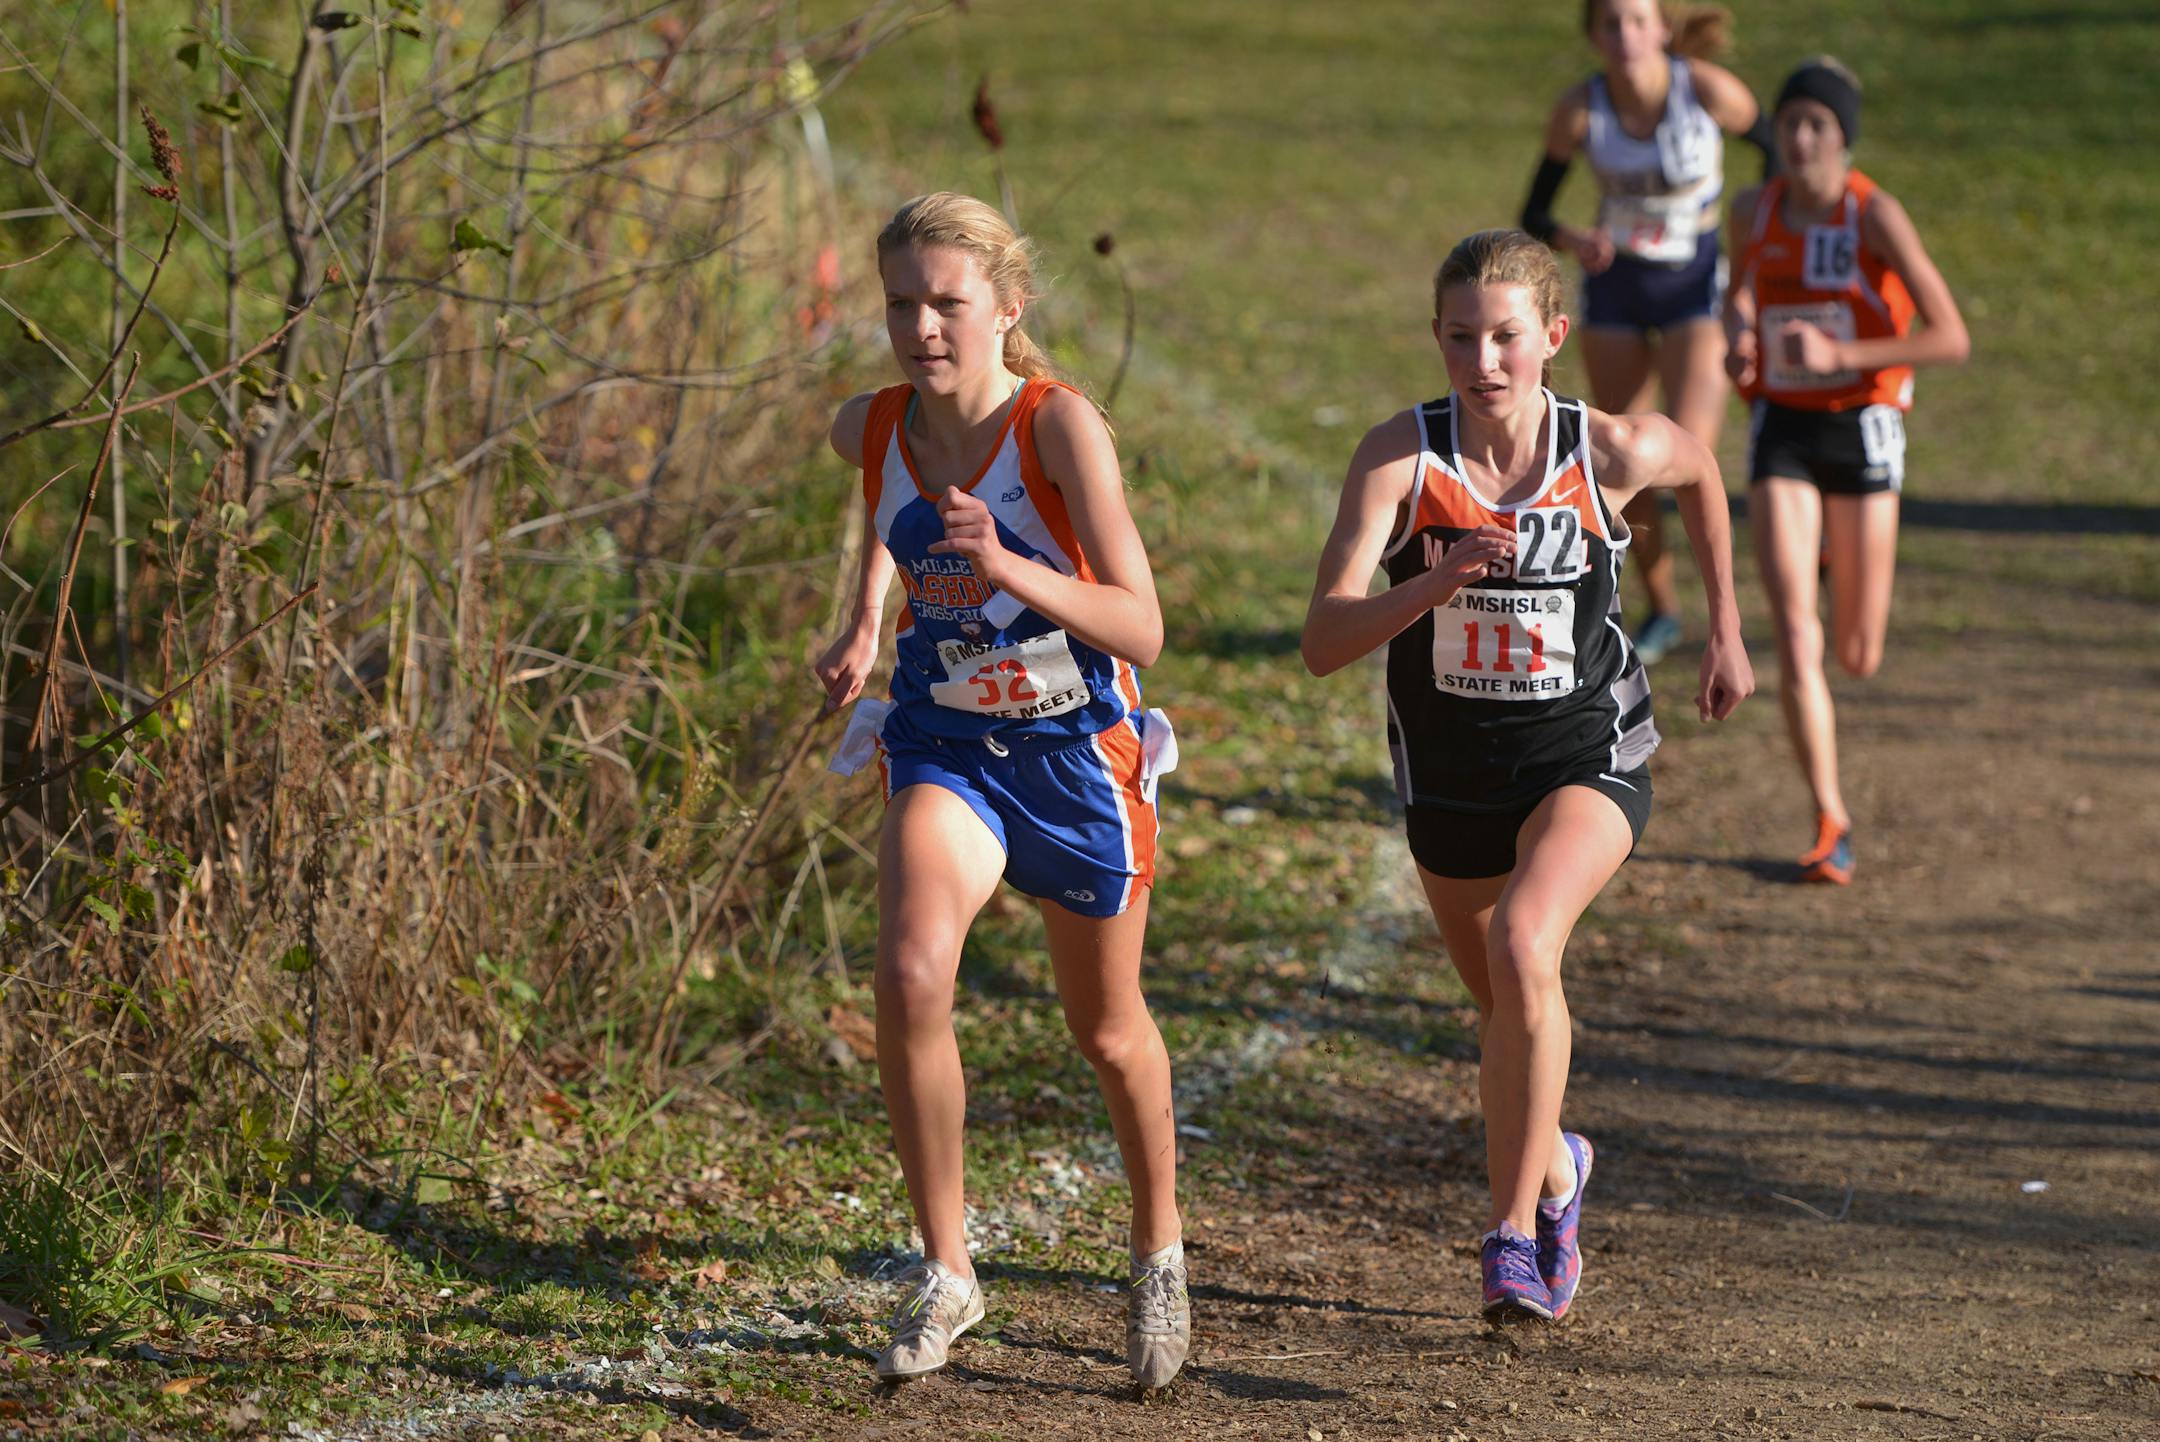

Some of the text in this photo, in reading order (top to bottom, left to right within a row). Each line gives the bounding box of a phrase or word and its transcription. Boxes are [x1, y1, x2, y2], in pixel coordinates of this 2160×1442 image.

[1813, 234, 1853, 277] 16
[1519, 510, 1577, 577] 22
[911, 558, 973, 574] MILLE
[1466, 594, 1542, 614] MSHSL
[1462, 621, 1546, 672] 111
[968, 658, 1039, 706] 52
[1444, 674, 1563, 693] STATE MEET
[1019, 688, 1075, 719] MEET
